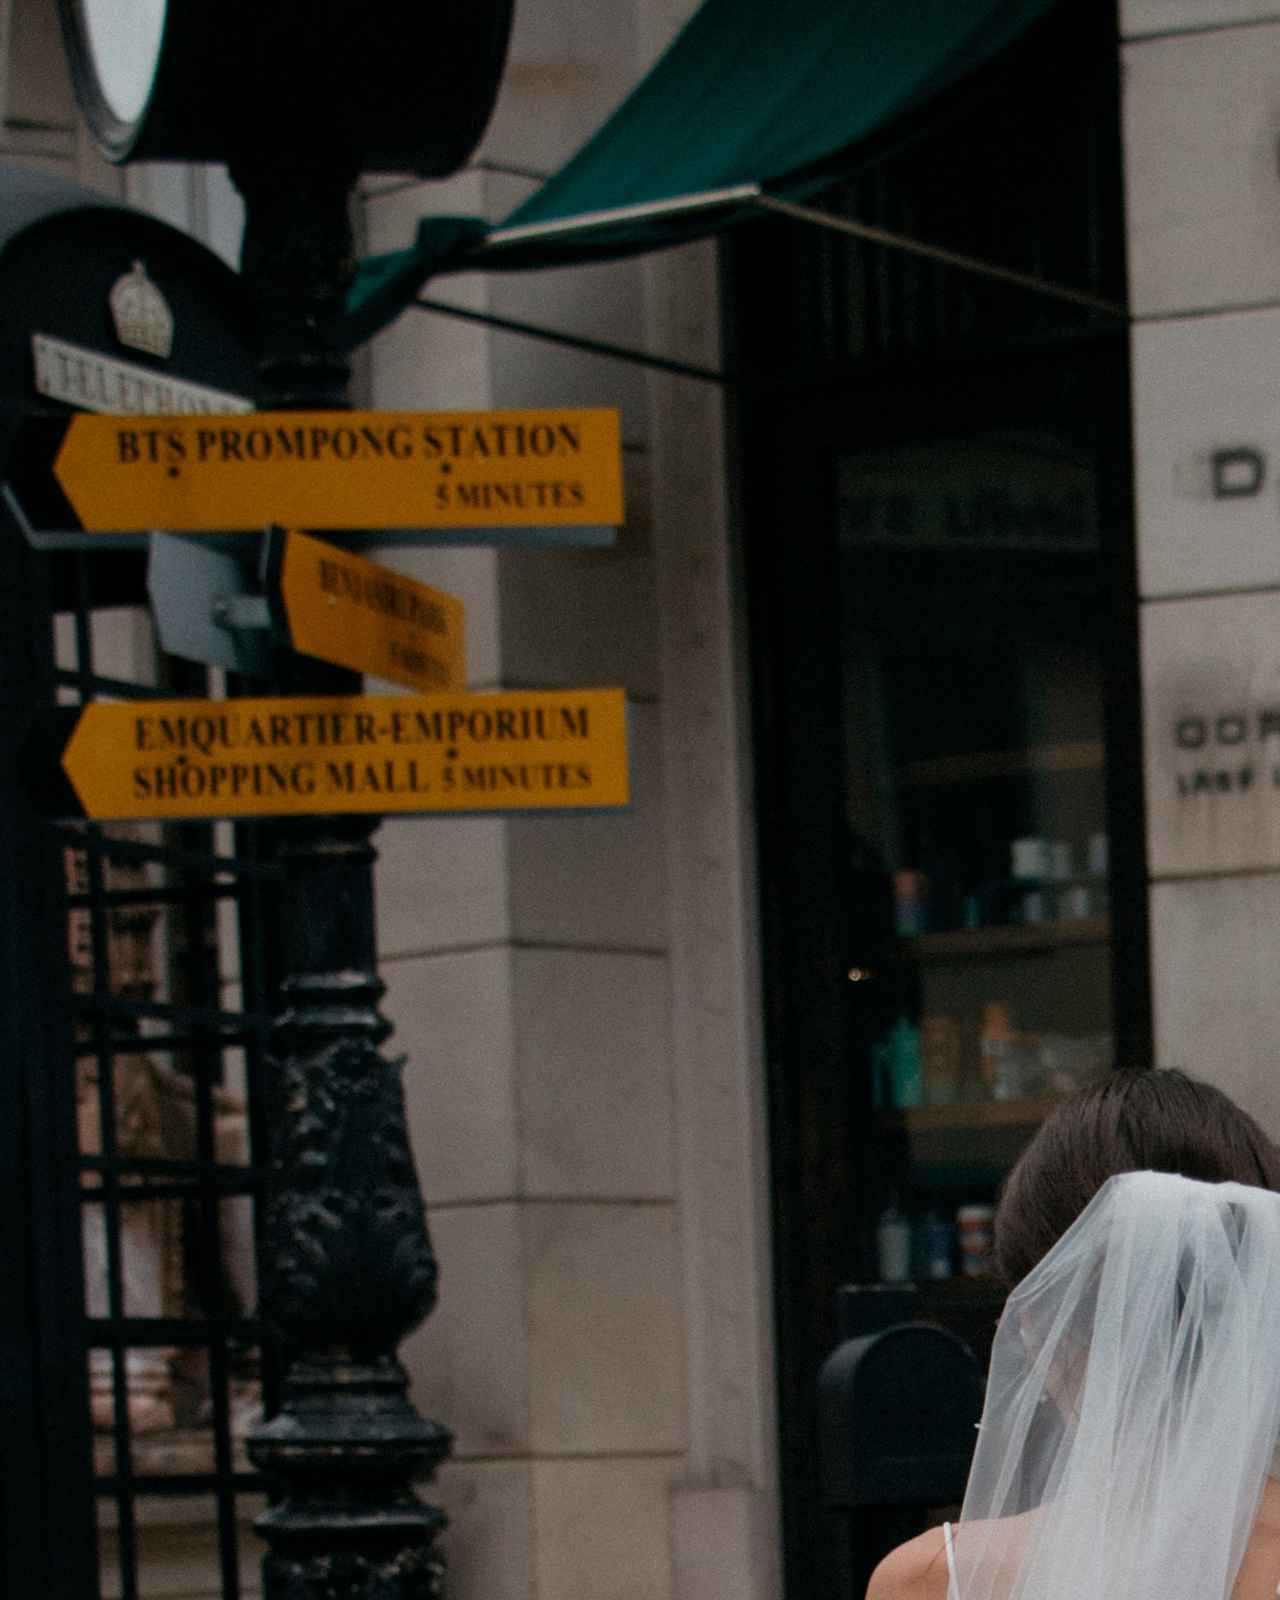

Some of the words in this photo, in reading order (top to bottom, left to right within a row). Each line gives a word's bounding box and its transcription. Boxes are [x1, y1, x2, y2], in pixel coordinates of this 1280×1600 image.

[55, 350, 240, 415] TELEPHO
[117, 428, 188, 463] BTS
[196, 422, 413, 461] PROMPONG
[423, 423, 582, 458] STATION
[434, 484, 449, 510] 5
[456, 481, 586, 509] MINUTES
[134, 706, 590, 756] EMQUARTIER-EMPORIUM
[133, 760, 315, 800] SHOPPING
[325, 759, 430, 793] MALL
[442, 766, 458, 793] 5
[462, 763, 591, 792] MINUTES
